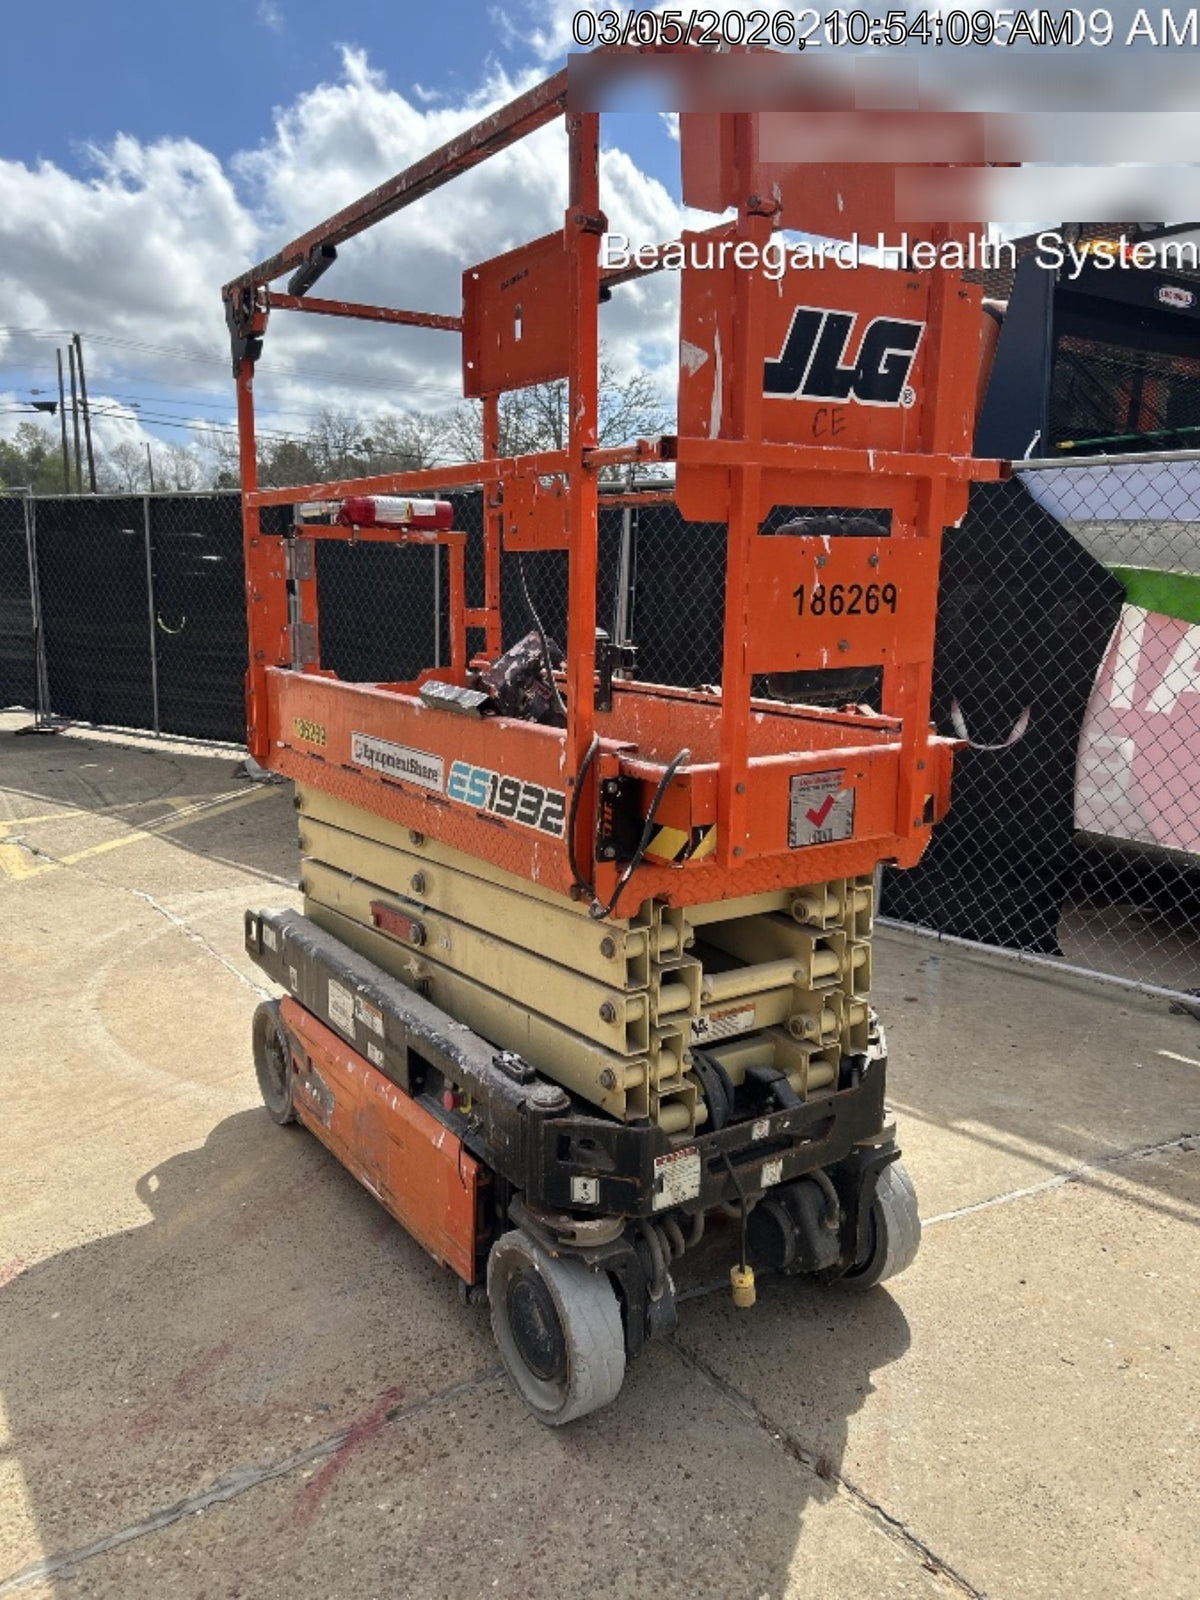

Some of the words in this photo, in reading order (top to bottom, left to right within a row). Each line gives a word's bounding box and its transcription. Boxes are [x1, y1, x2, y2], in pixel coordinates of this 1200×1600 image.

[812, 407, 848, 438] CE
[792, 582, 898, 616] 186269
[448, 760, 566, 838] ES1932
